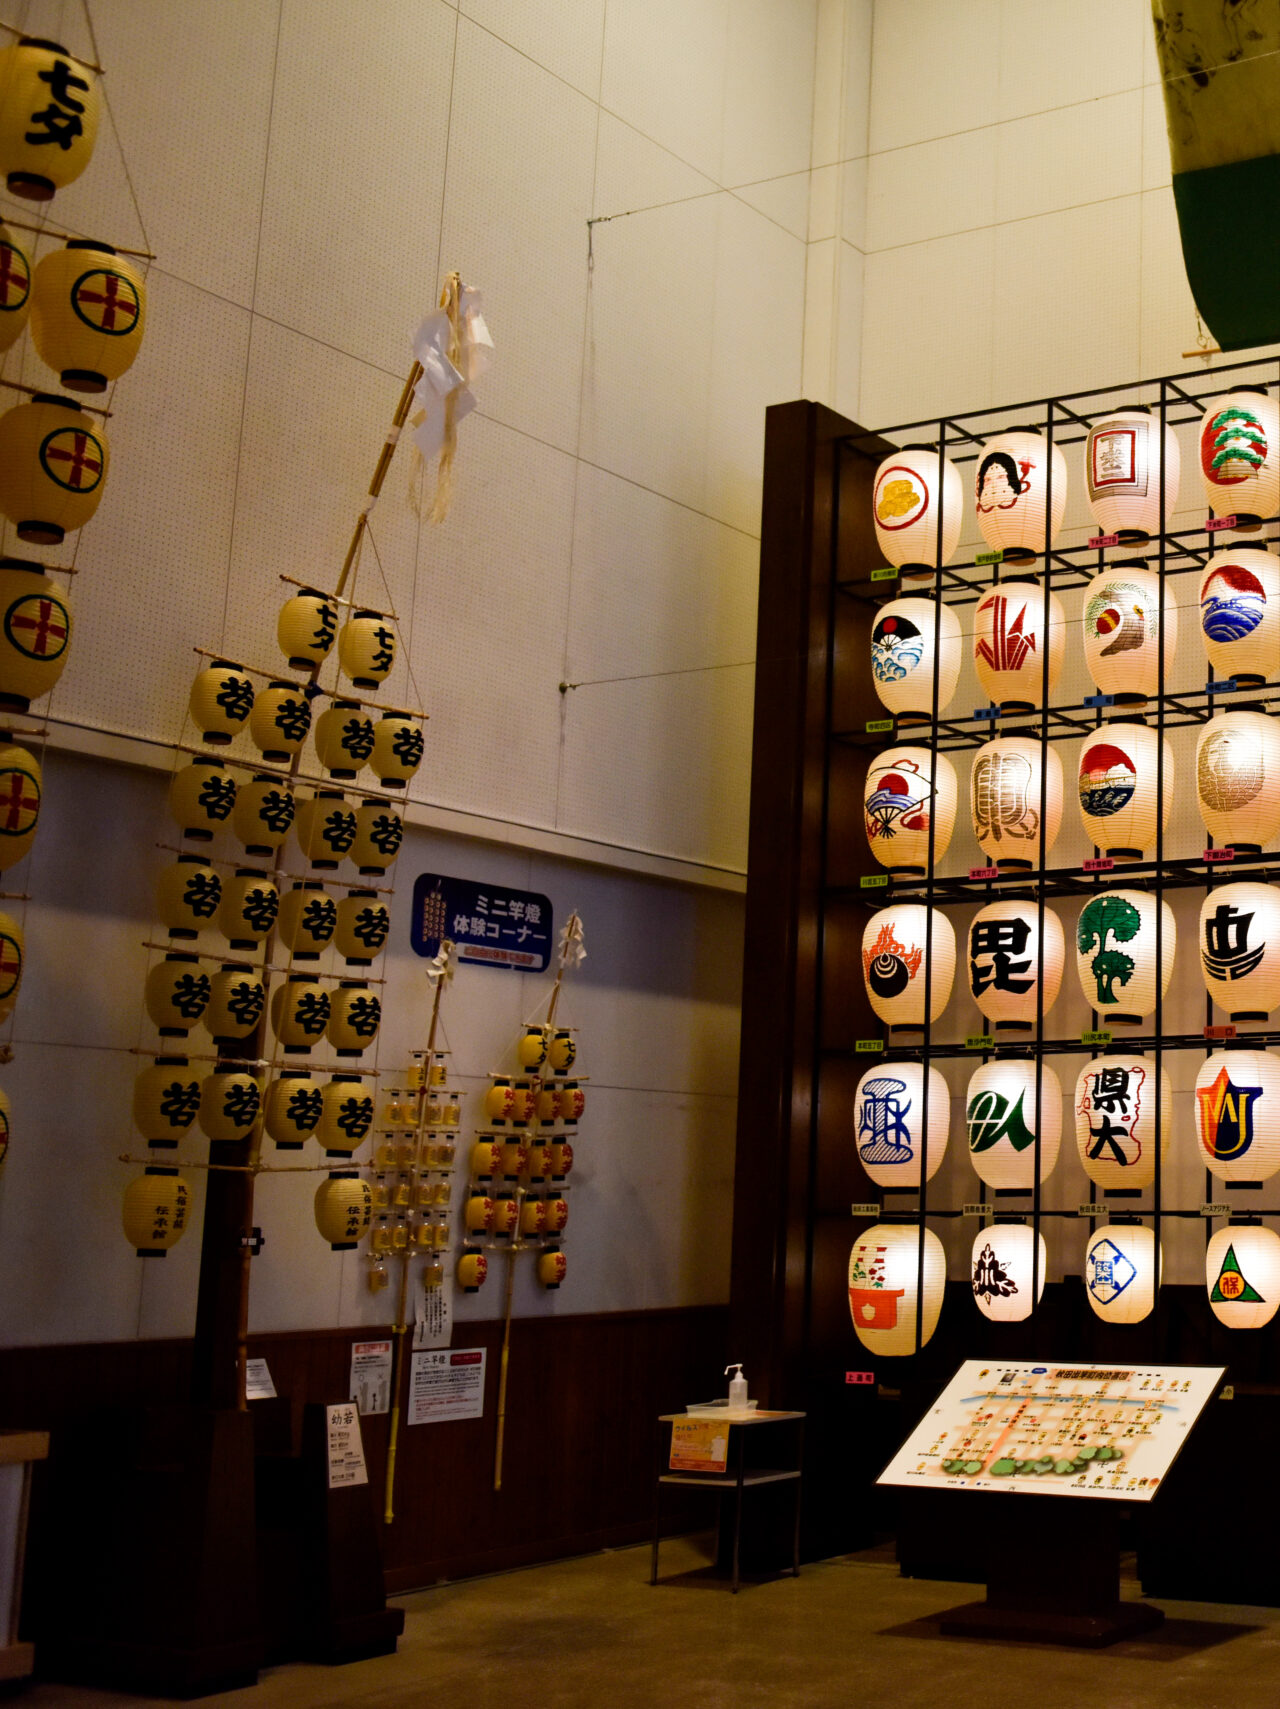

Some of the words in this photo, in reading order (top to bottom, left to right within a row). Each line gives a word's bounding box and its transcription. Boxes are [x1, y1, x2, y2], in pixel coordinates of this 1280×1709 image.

[25, 60, 89, 151] 七夕
[309, 604, 338, 652] 七夕
[369, 627, 395, 672] 七夕
[453, 914, 547, 943] 体験コーナー
[476, 894, 541, 924] ミニ竿燈
